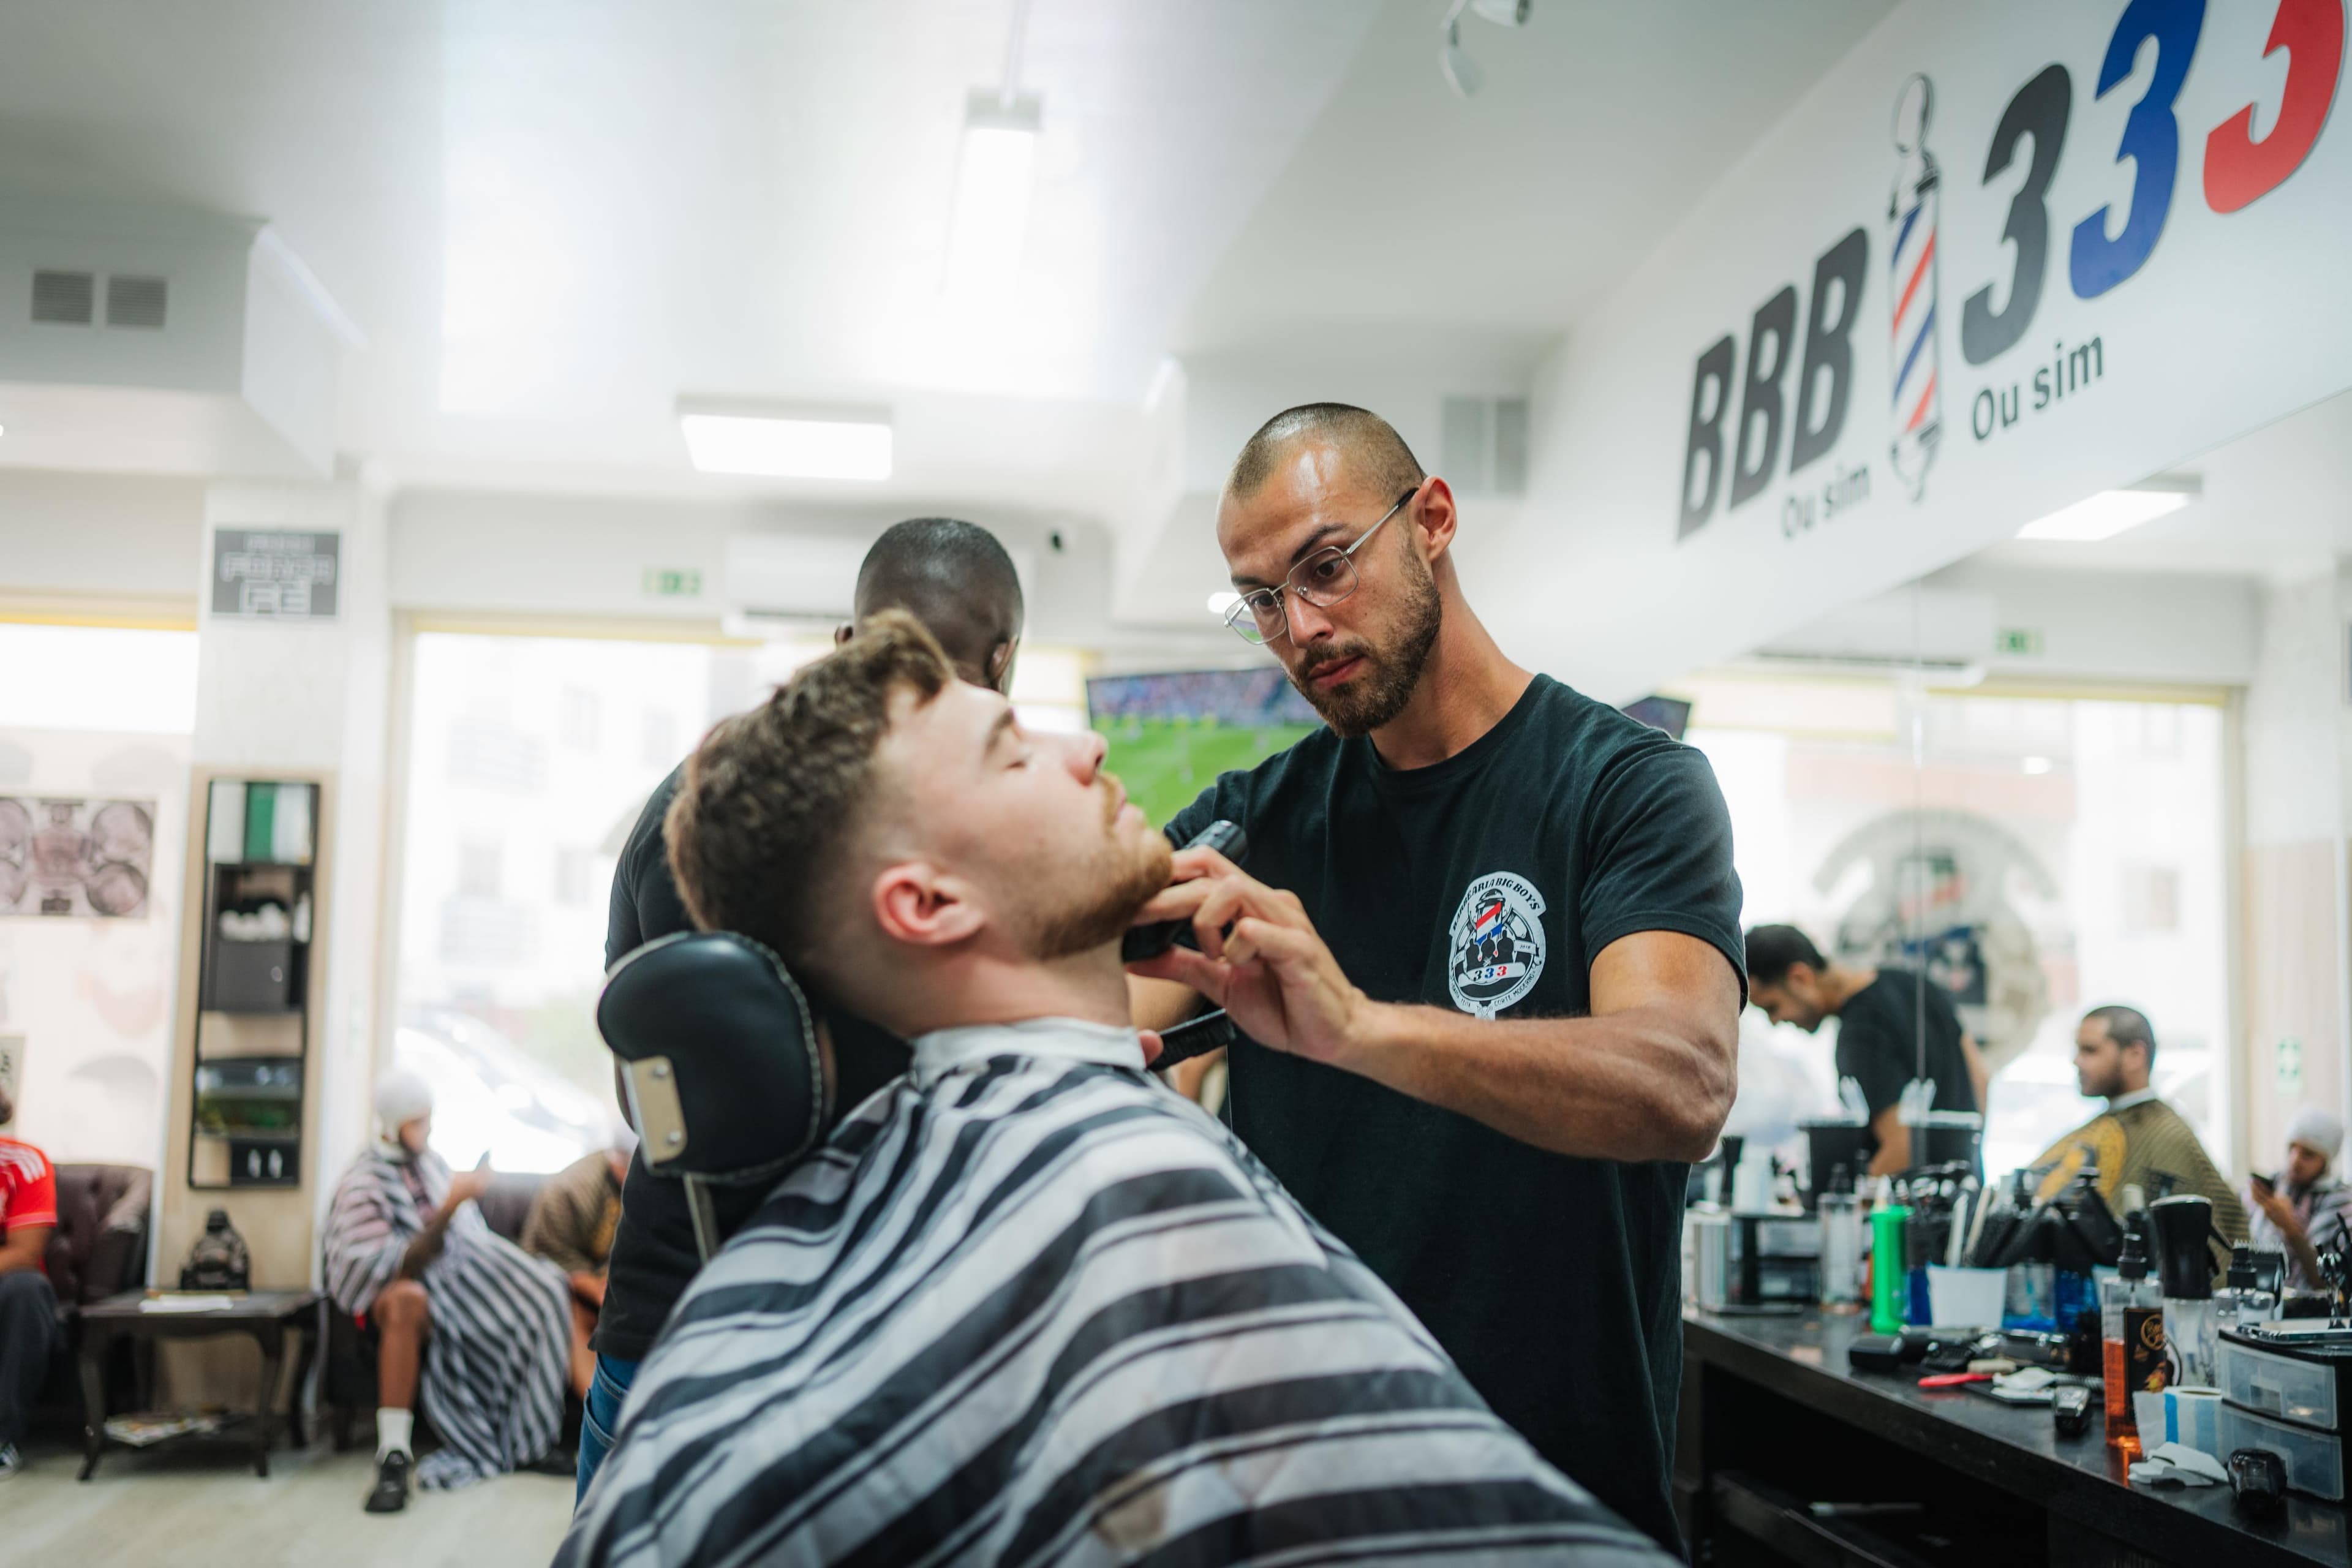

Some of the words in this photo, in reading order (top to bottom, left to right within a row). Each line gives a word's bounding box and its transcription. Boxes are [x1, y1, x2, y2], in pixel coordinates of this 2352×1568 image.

[1676, 227, 1870, 541] BBB
[1961, 0, 2345, 366] 333
[1972, 385, 2019, 441] Ou
[2034, 336, 2103, 410] sim
[1782, 497, 1813, 539] Ou
[1825, 464, 1869, 518] sim
[1496, 878, 1514, 888] BIG
[1513, 883, 1540, 910] BOYS
[1494, 994, 1512, 1006] CORTE
